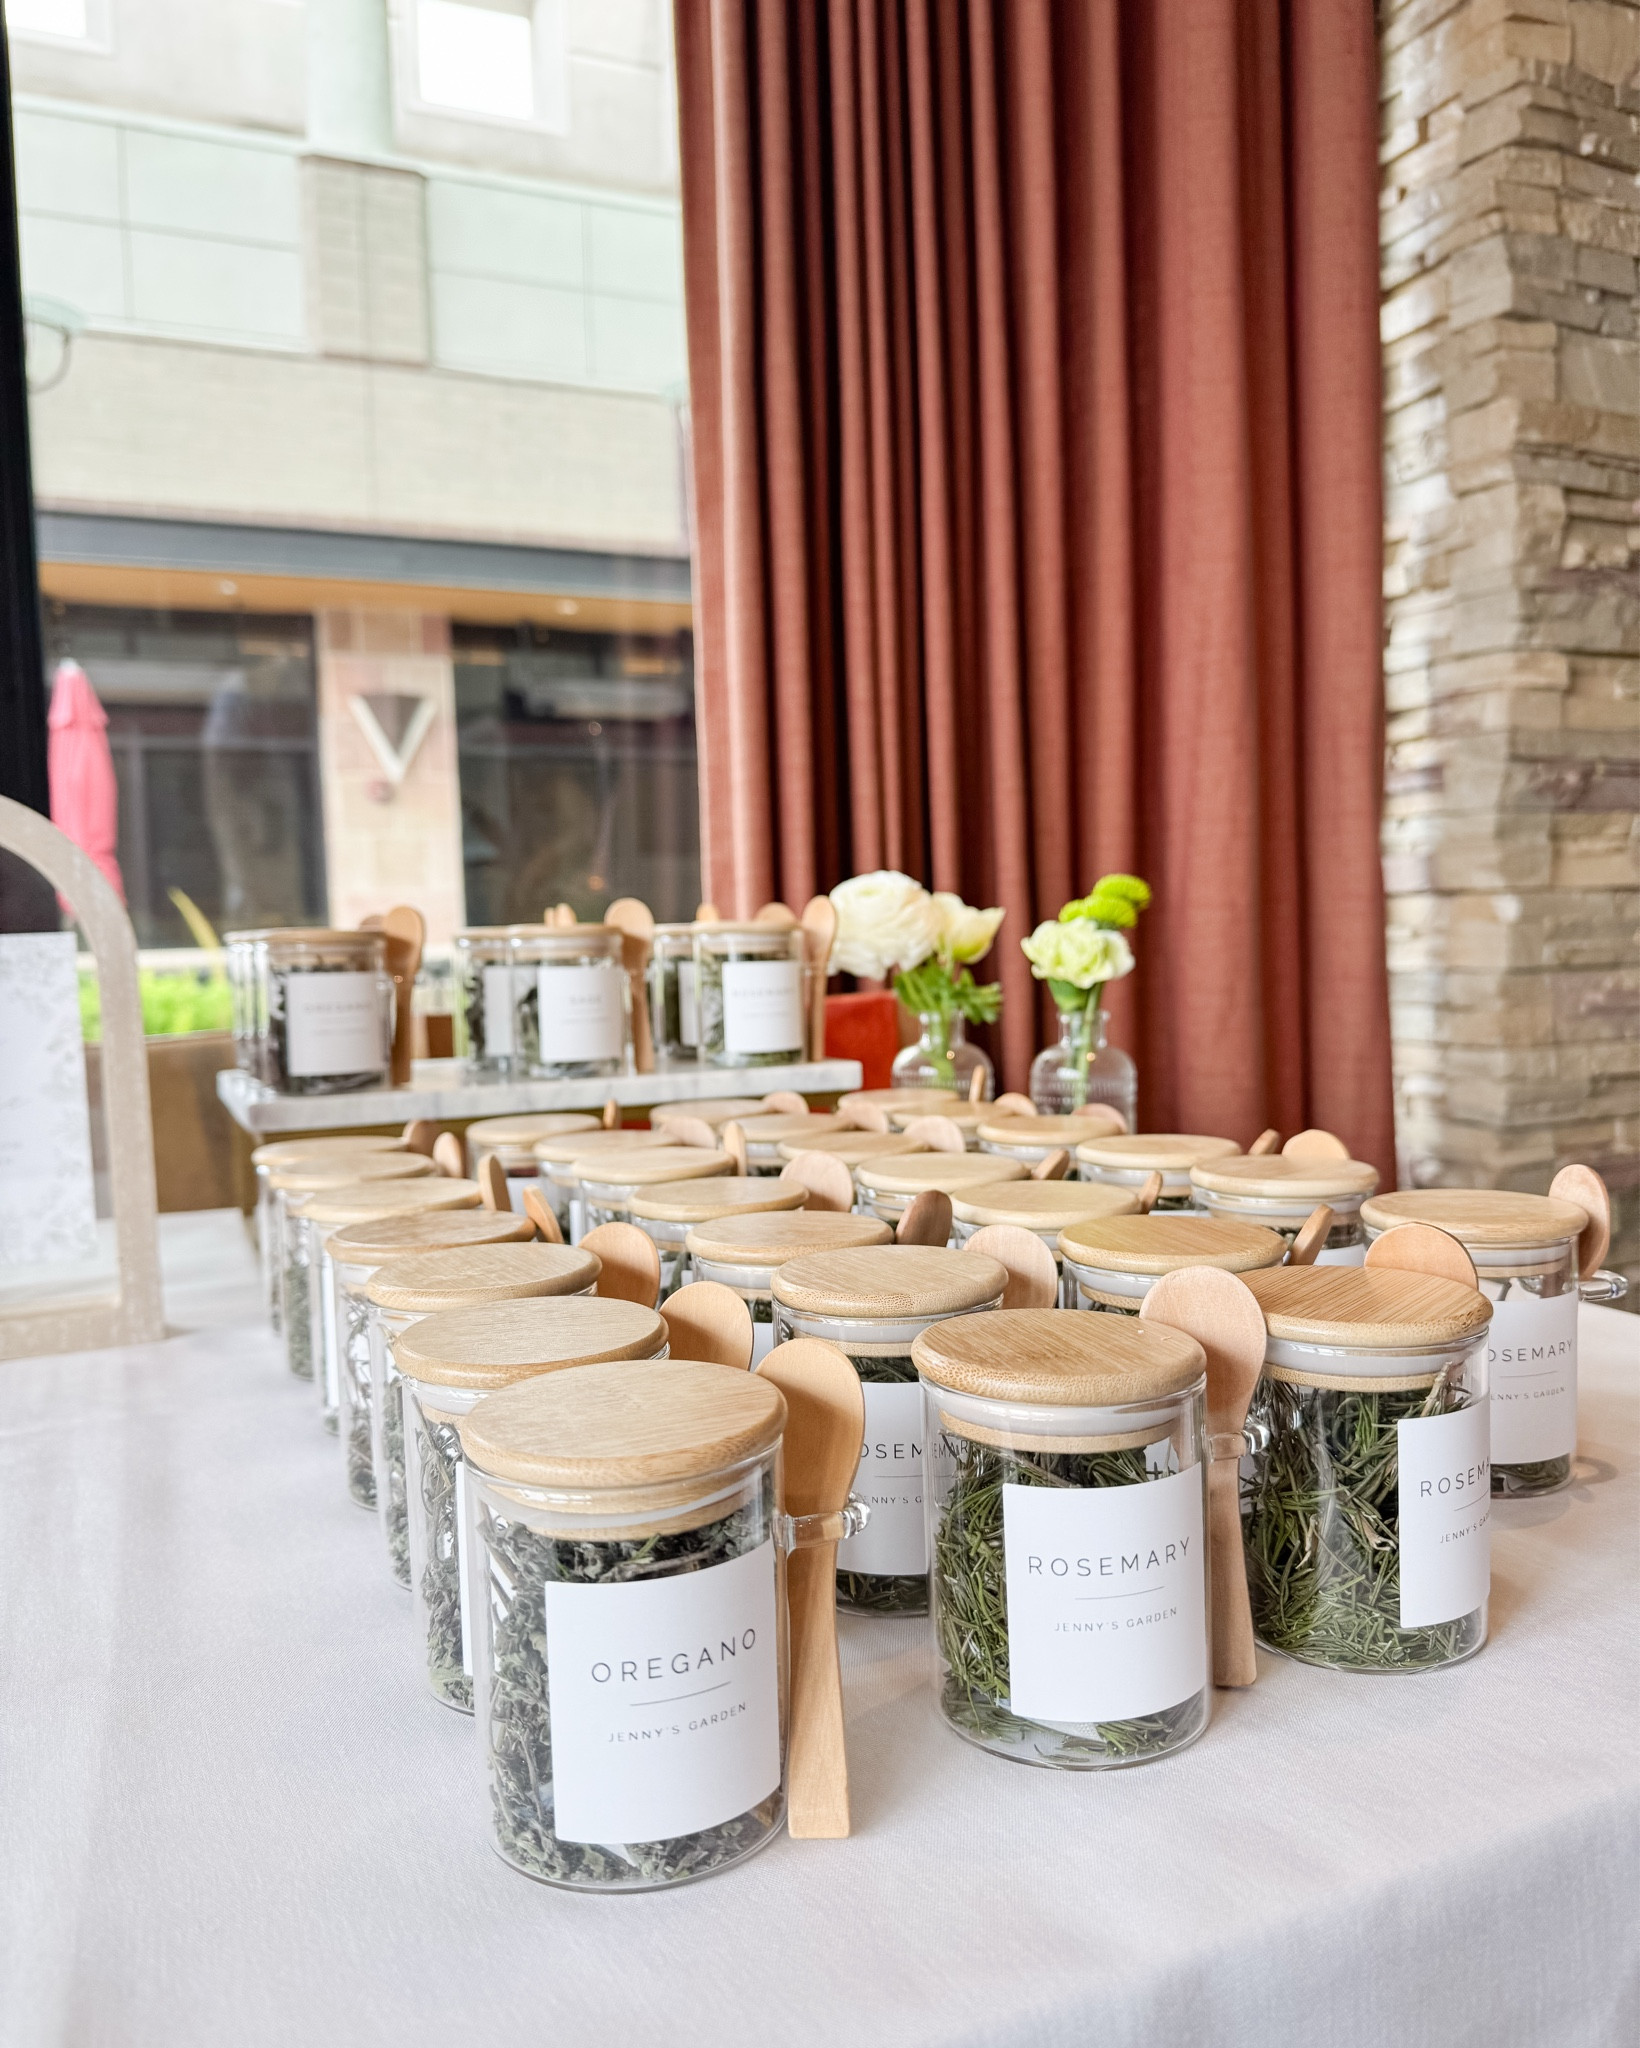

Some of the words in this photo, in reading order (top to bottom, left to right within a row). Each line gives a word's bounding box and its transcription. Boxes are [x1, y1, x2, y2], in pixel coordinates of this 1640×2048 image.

[1489, 1337, 1573, 1362] OSEMARY
[1491, 1393, 1529, 1401] ENNY'S
[861, 1443, 923, 1459] OSEM
[1420, 1456, 1490, 1498] ROSEMA
[1440, 1523, 1477, 1544] JENNY'S
[1028, 1536, 1190, 1577] ROSEMARY
[1054, 1621, 1119, 1632] JENNY'S
[1126, 1606, 1178, 1628] GARDEN
[591, 1628, 756, 1683] OREGANO
[608, 1724, 680, 1743] JENNY'S
[688, 1702, 746, 1731] GARDEN
